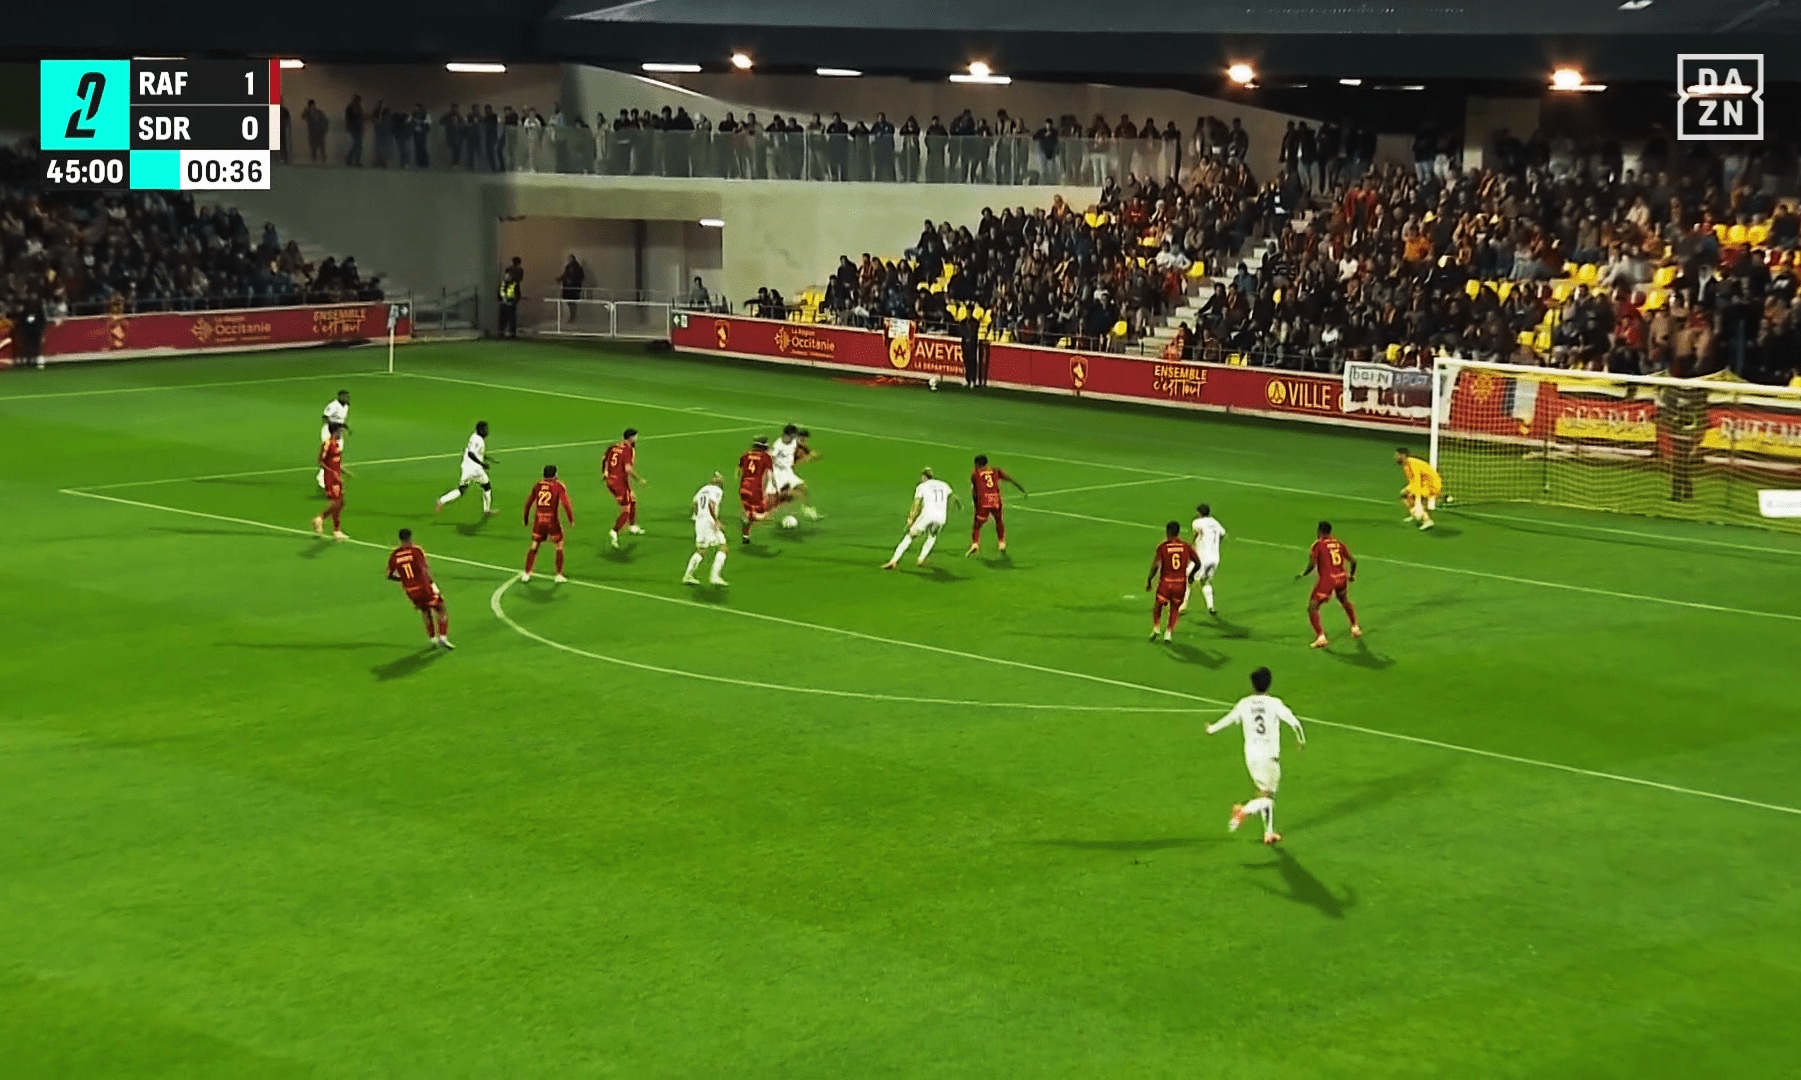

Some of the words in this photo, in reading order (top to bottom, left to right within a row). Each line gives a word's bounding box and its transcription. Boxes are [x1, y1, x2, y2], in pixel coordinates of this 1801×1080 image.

[215, 322, 271, 335] Occitanie
[791, 335, 835, 351] Occitanie
[1154, 364, 1207, 380] ENSEMBLE
[1288, 381, 1331, 410] VILLE
[610, 453, 619, 467] 5
[748, 460, 756, 474] 4
[984, 474, 994, 488] 3
[538, 490, 552, 506] 22
[1171, 553, 1181, 570] 6
[402, 562, 415, 579] 11
[1254, 714, 1266, 735] 3
